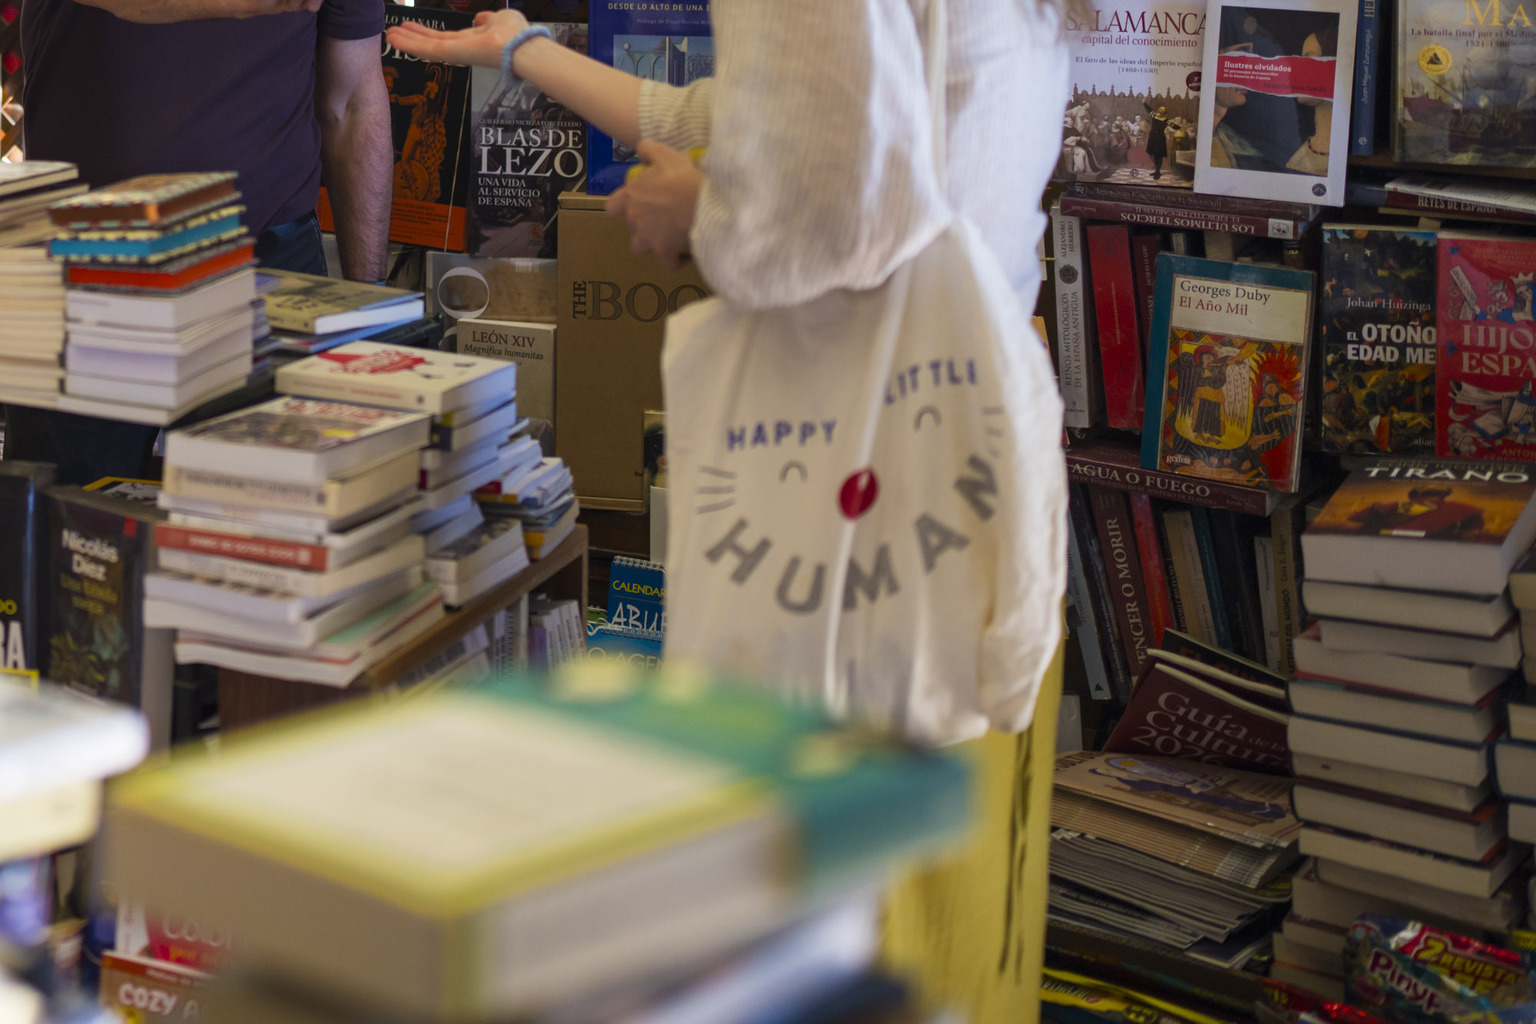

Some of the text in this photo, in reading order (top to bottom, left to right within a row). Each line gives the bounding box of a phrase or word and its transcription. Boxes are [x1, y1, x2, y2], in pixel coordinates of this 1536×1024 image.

[1066, 9, 1208, 36] SALAMANCA
[480, 127, 583, 148] BLAS DE
[478, 146, 584, 178] LEZO
[478, 178, 526, 188] UNA VIDA
[478, 187, 541, 198] AL SERVICIO
[478, 195, 532, 208] DE ESPAÑA
[1418, 195, 1445, 209] REYES
[1448, 199, 1458, 210] DE
[572, 281, 587, 320] THE
[1180, 281, 1271, 306] Georges Duby
[472, 330, 535, 349] LEÓN XIV
[1347, 322, 1436, 345] EL OTOÑO
[465, 343, 544, 360] Magnifica humanitas
[1348, 344, 1399, 362] EDAD
[727, 420, 837, 453] HAPPY
[1366, 467, 1529, 483] TIRANO
[705, 454, 999, 616] HUMAN
[1106, 517, 1122, 574] MORIR
[1158, 692, 1249, 739] Guía
[119, 982, 178, 1015] COZY
